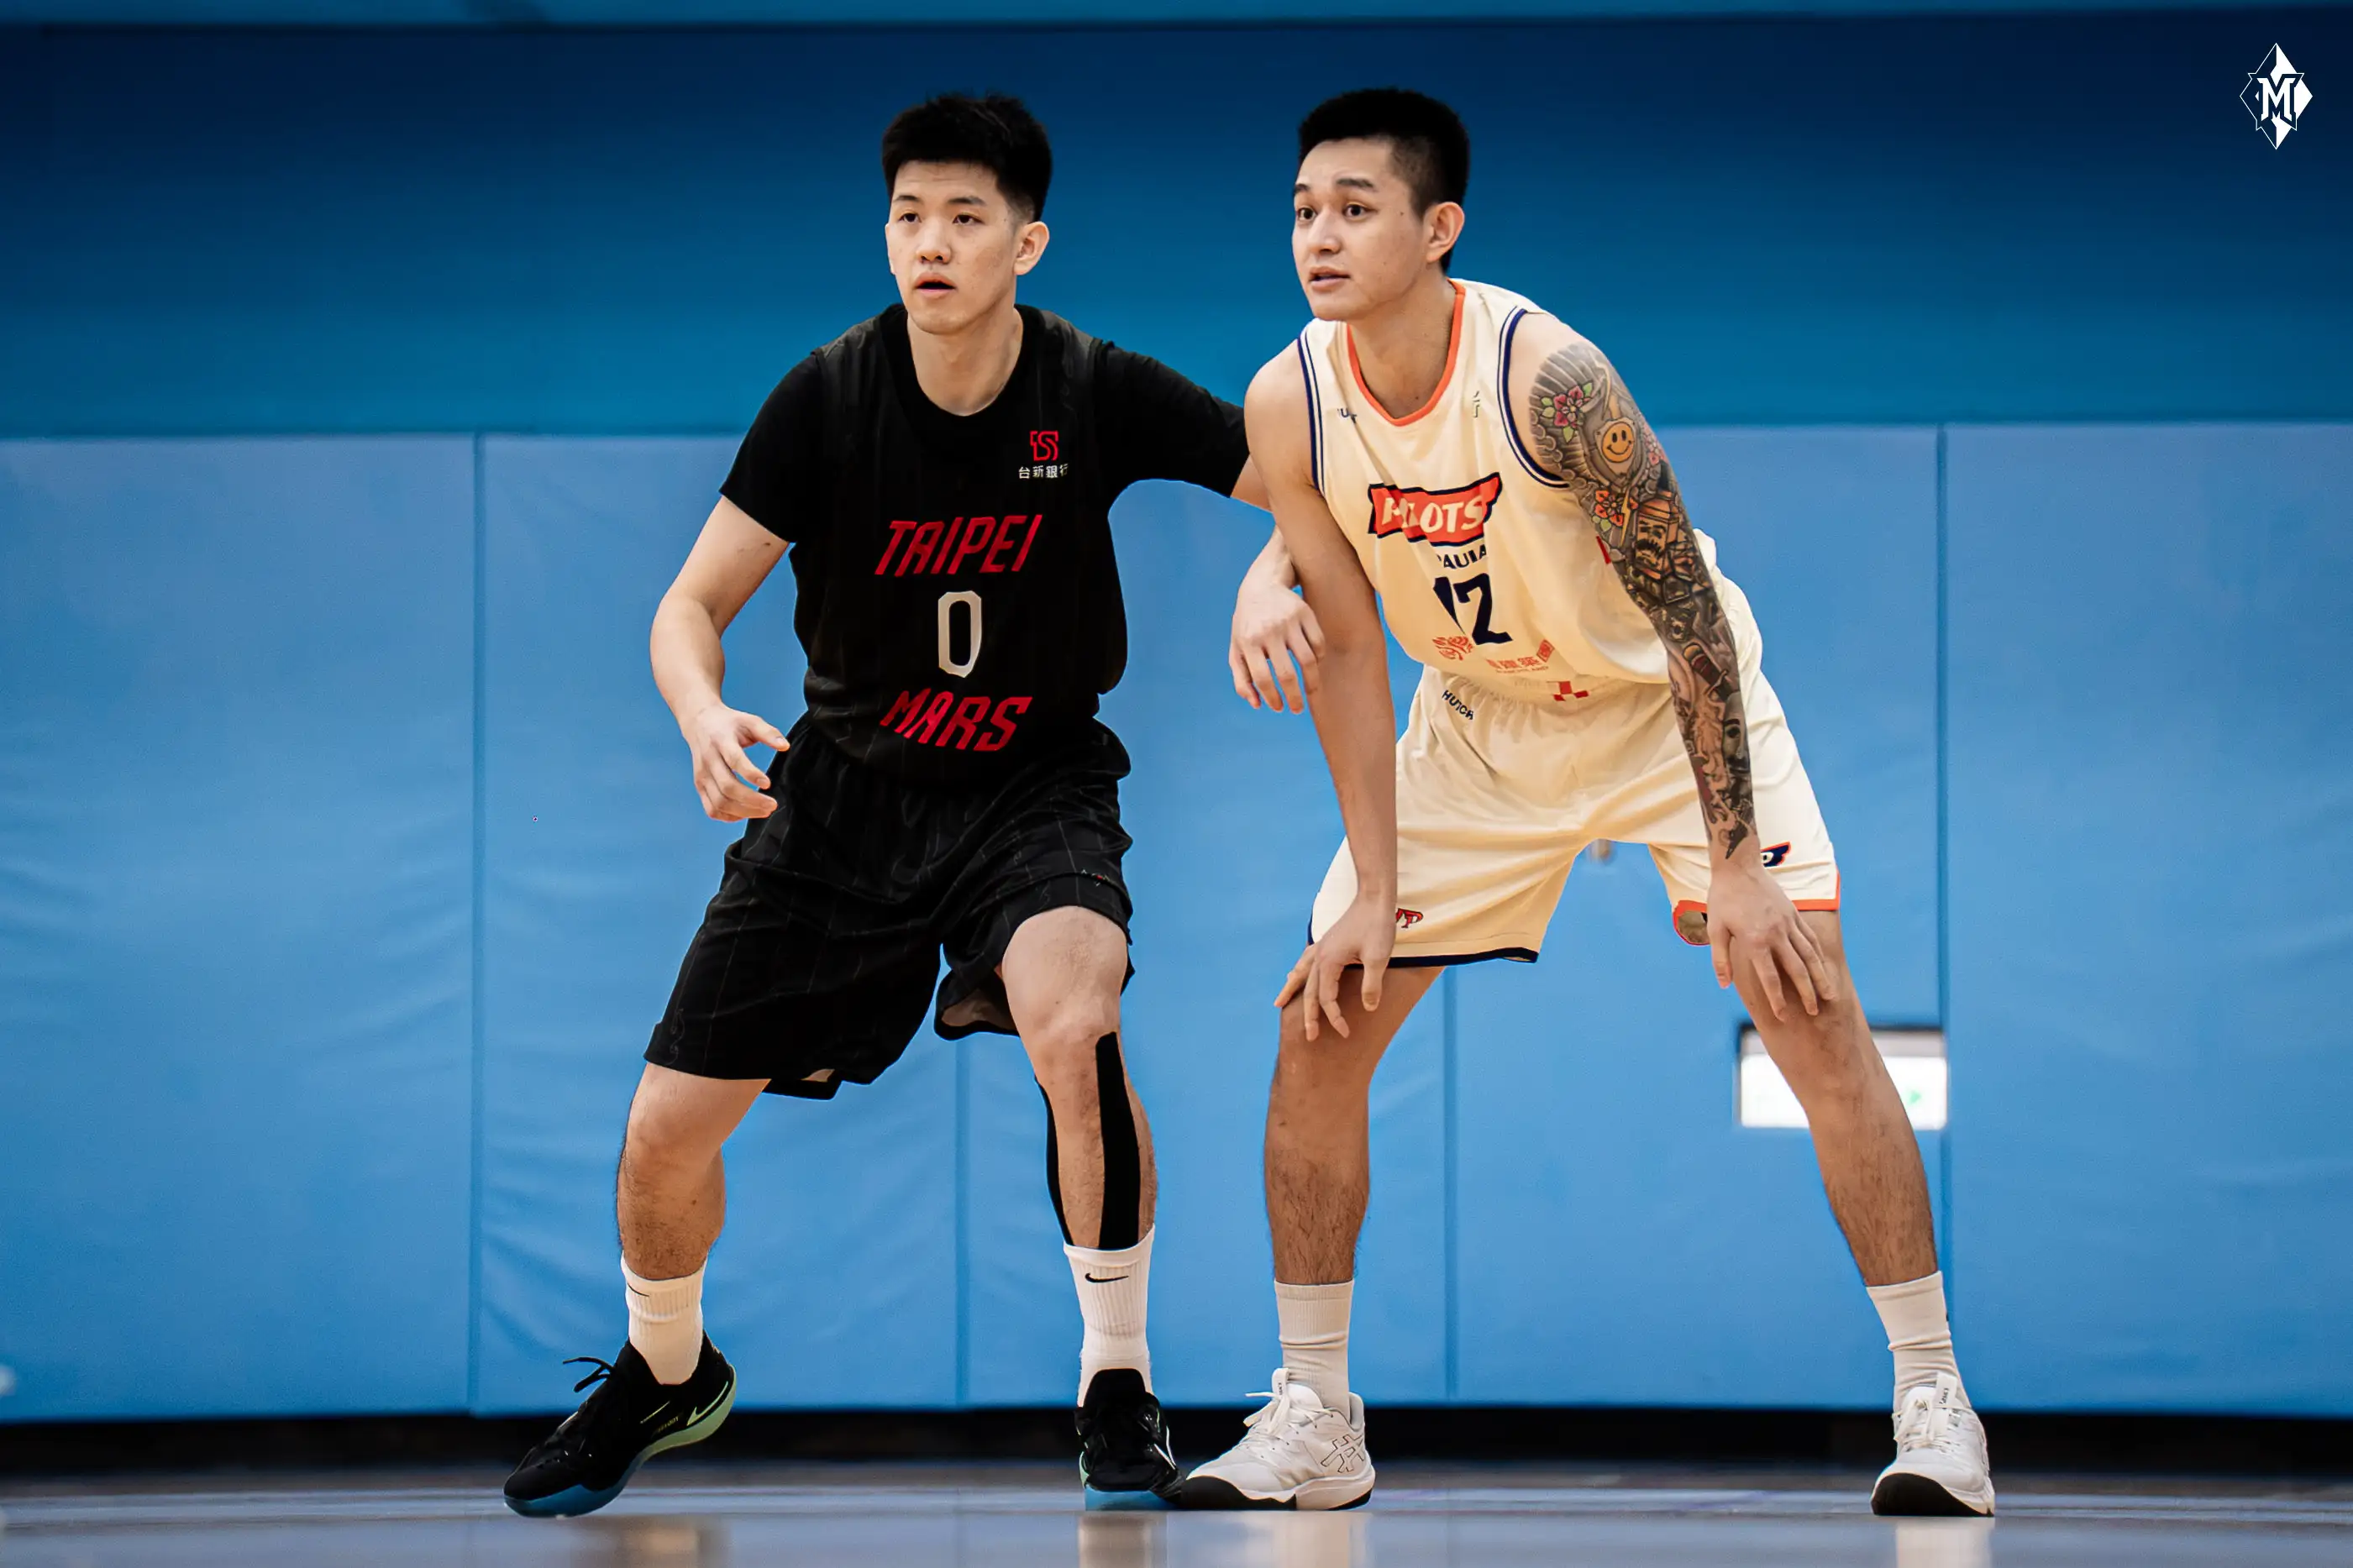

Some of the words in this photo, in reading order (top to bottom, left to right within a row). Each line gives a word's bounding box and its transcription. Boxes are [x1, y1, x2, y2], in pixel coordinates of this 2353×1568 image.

[1018, 463, 1069, 480] 台新銀行
[874, 514, 1043, 578] TAIPEI
[938, 590, 983, 679] 0
[1432, 572, 1513, 646] 12
[879, 688, 1033, 752] MARS
